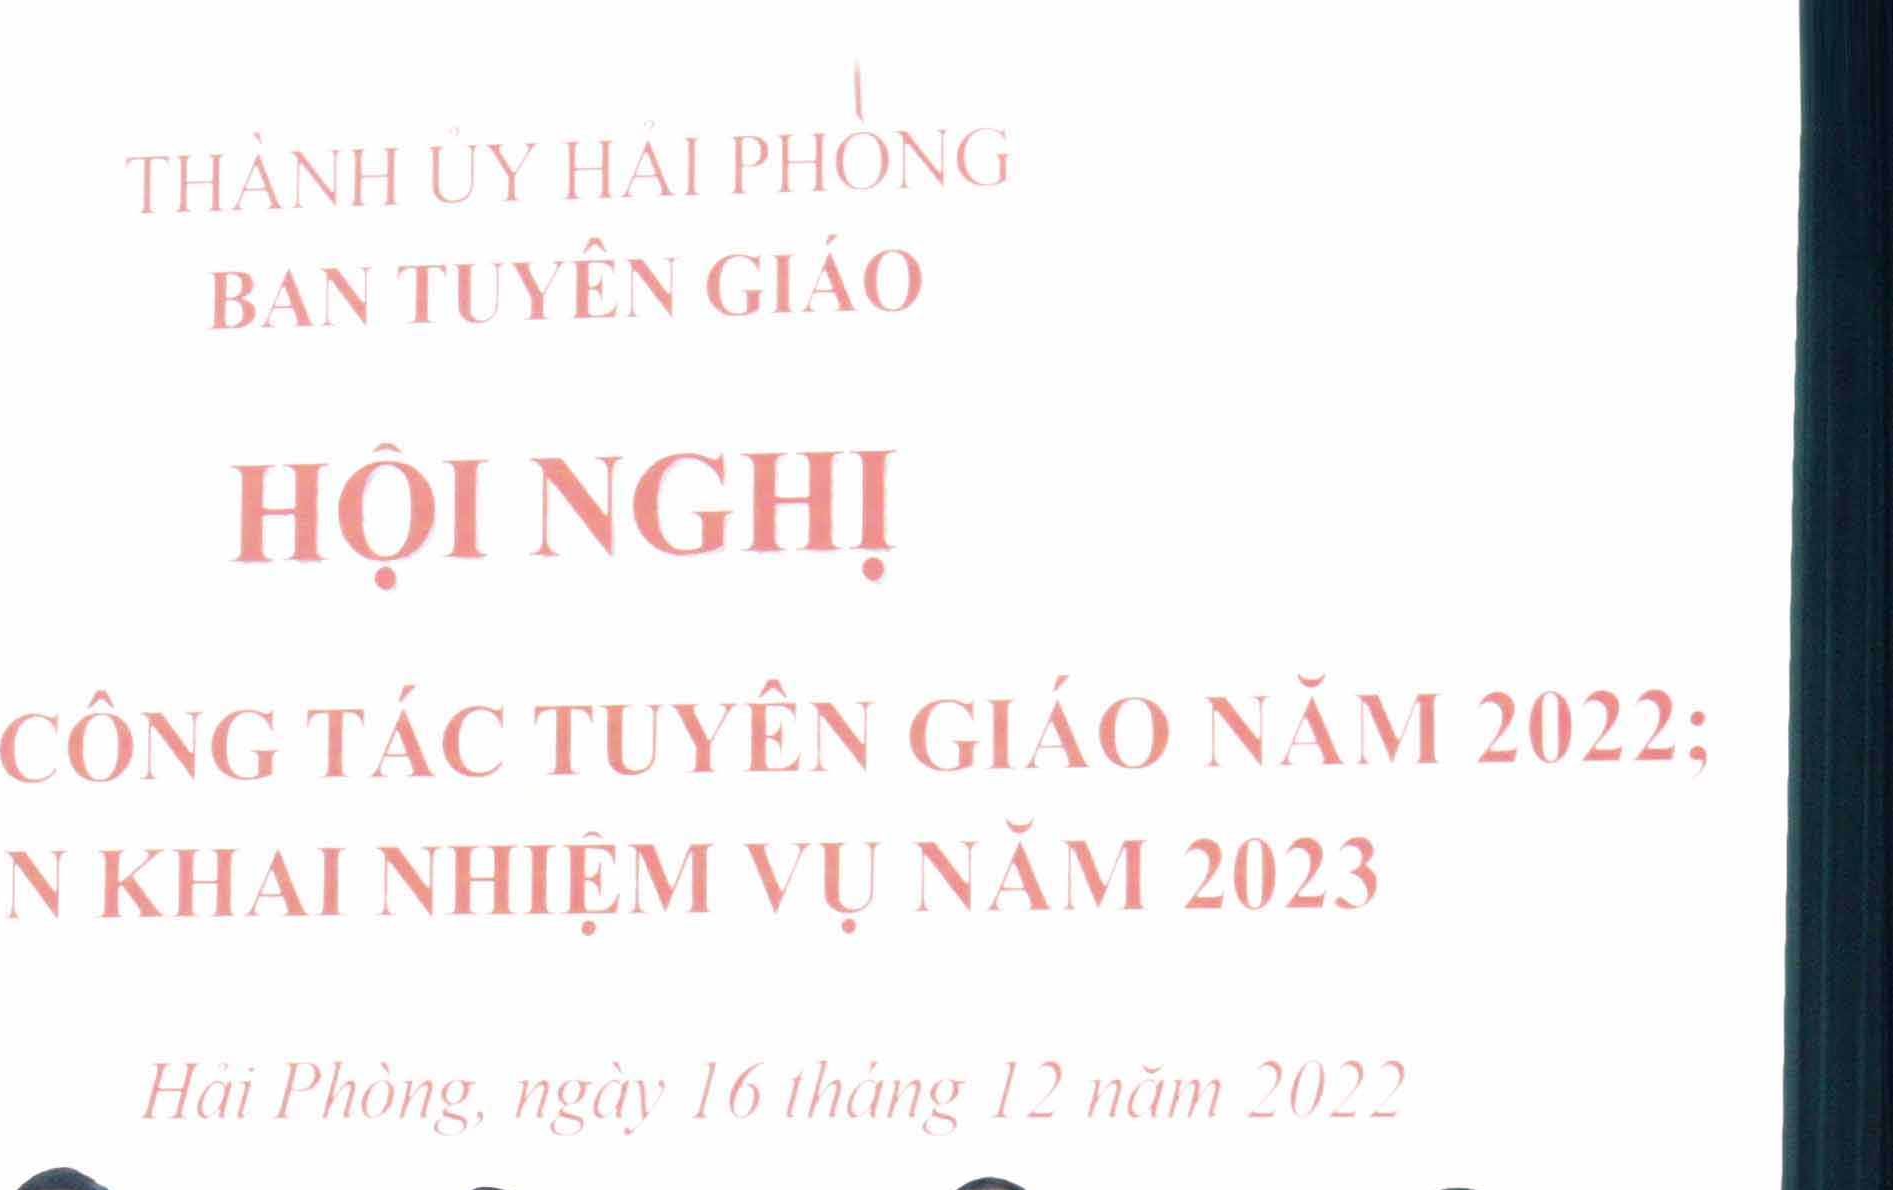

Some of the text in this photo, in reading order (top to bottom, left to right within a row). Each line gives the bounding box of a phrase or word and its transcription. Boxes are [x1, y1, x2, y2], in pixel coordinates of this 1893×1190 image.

[124, 72, 1012, 215] THÀNH ỦY HẢI PHÒNG
[210, 233, 924, 331] BAN TUYÊN GIÁO
[229, 441, 899, 592] HỘI NGHỊ
[305, 682, 506, 780] TÁC
[533, 677, 876, 778] TUYÊN
[908, 673, 1172, 773] GIÁO
[1205, 673, 1444, 768] NĂM
[1475, 688, 1710, 778] 2022;
[99, 846, 347, 921] KHAI
[378, 831, 714, 938] NHIỆM
[743, 840, 880, 936] VỤ
[914, 820, 1147, 913] NĂM
[1183, 835, 1381, 912] 2023
[141, 1056, 1407, 1138] Hải Phòng, ngày 16 tháng 12 năm 2022
